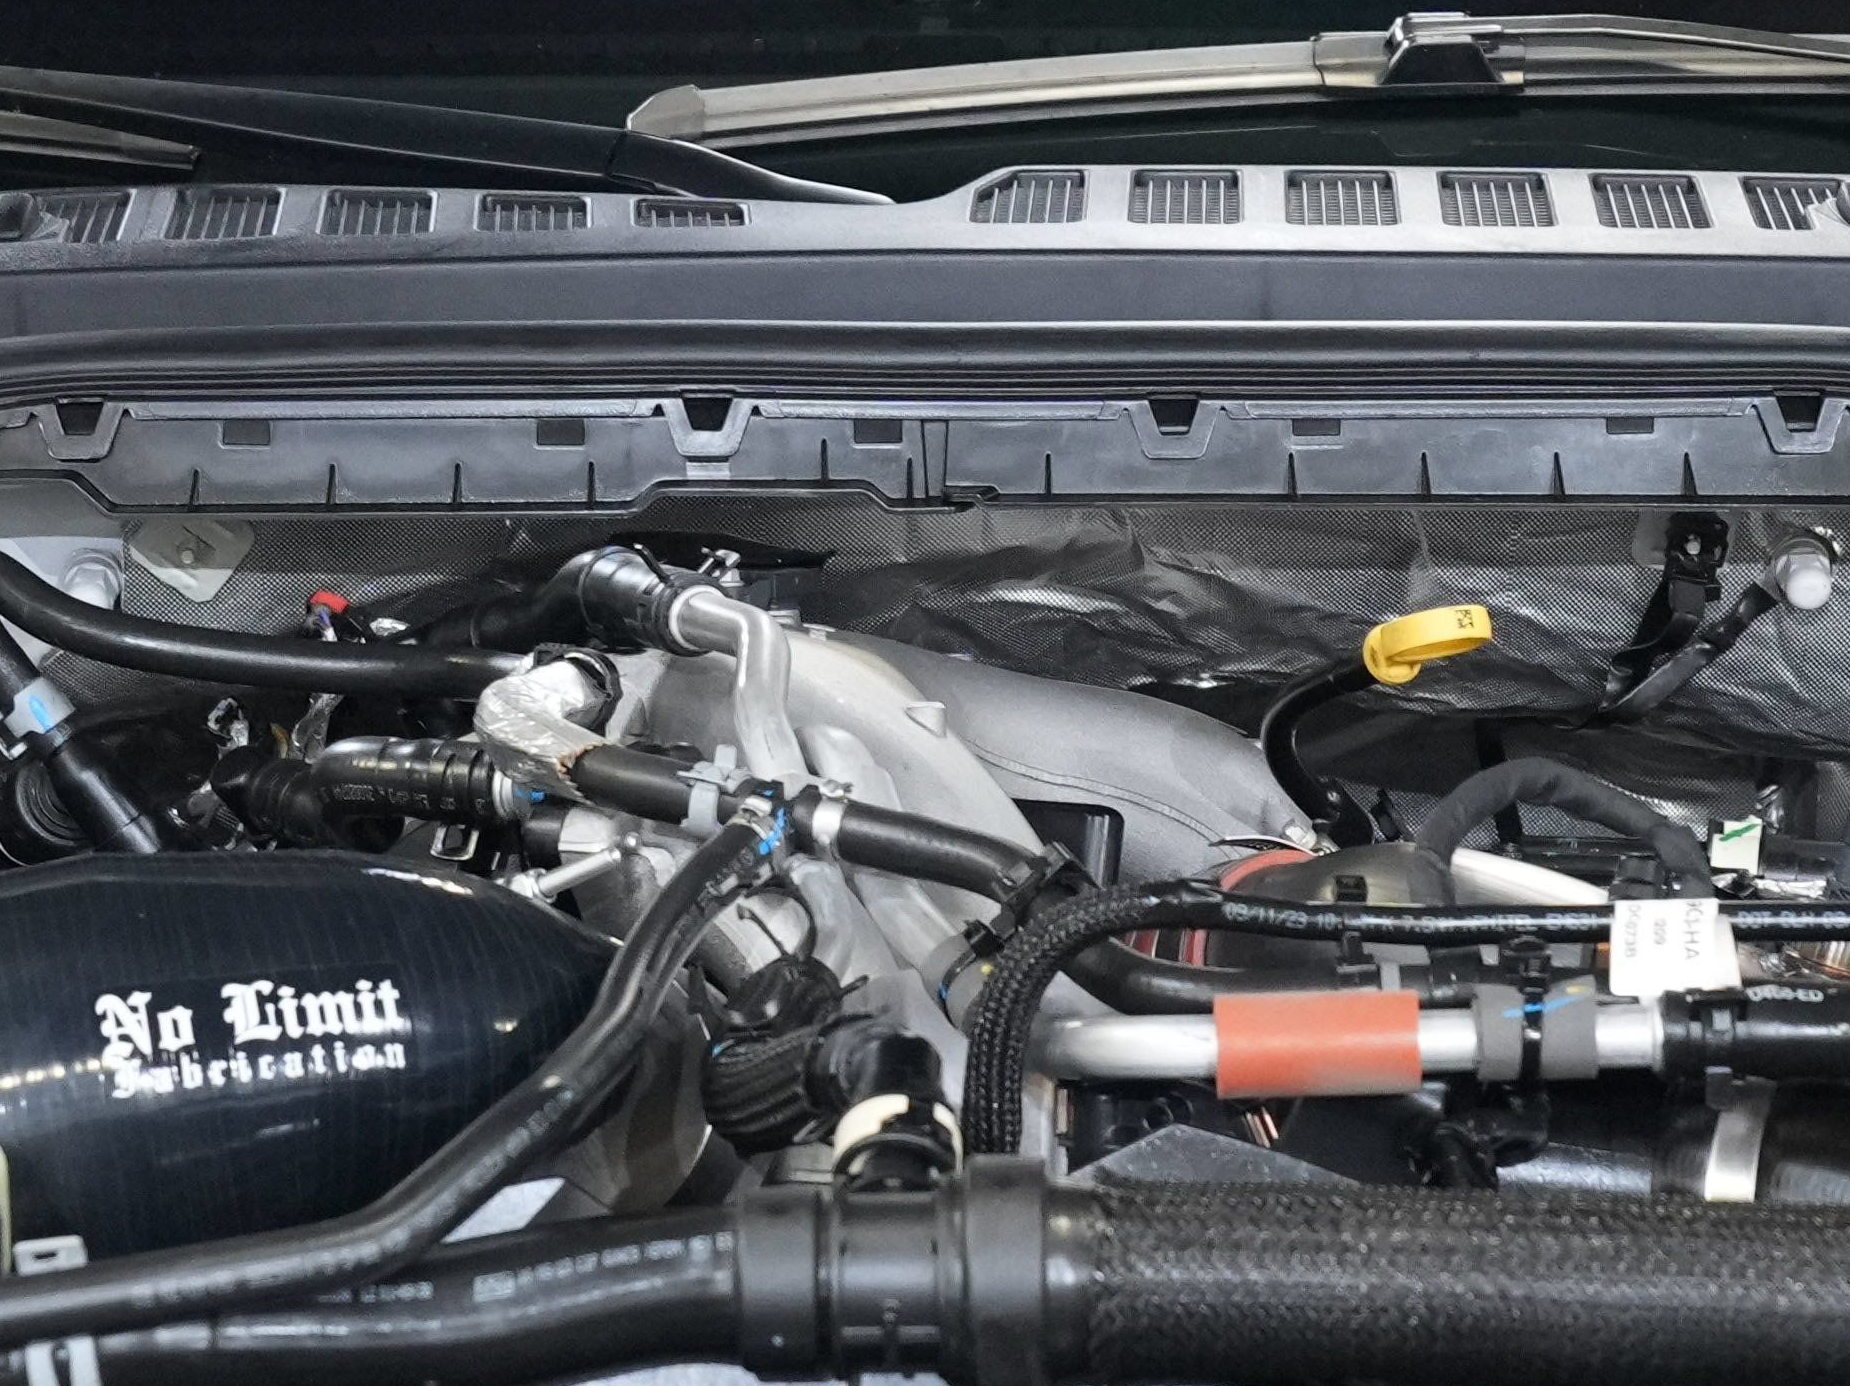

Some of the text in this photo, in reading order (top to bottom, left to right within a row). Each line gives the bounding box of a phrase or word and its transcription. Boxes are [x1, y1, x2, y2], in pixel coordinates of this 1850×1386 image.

[95, 979, 412, 1061] No Limit
[101, 1040, 406, 1099] Fabrication
